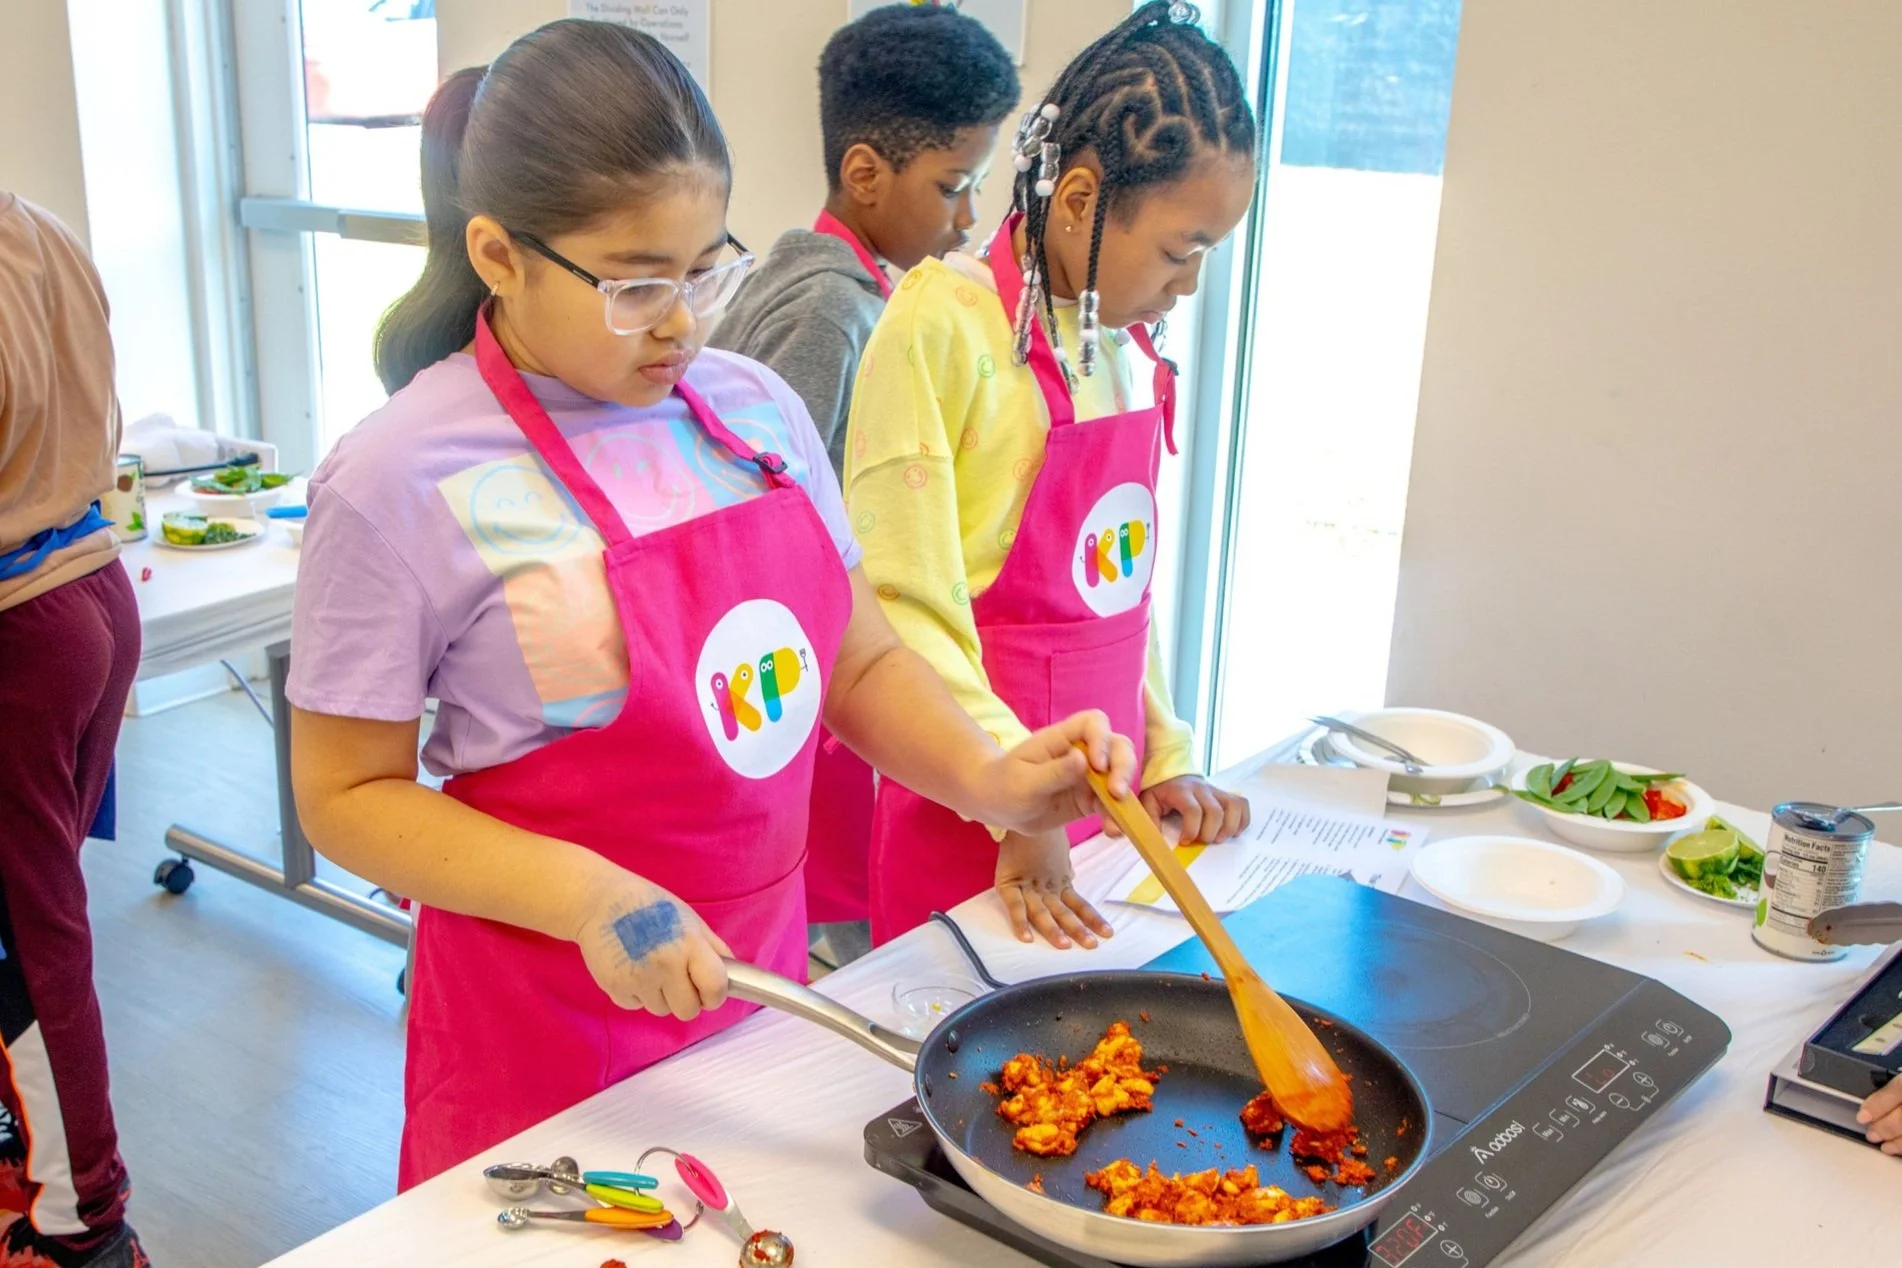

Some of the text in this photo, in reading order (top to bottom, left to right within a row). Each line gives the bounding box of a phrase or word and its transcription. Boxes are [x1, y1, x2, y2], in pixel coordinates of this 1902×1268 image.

[653, 5, 669, 15] Can
[671, 5, 689, 17] Only
[1084, 520, 1146, 588] KP
[710, 647, 802, 741] KP
[1784, 833, 1811, 848] Nutrition
[1811, 841, 1831, 853] Facts
[1812, 864, 1827, 873] 140
